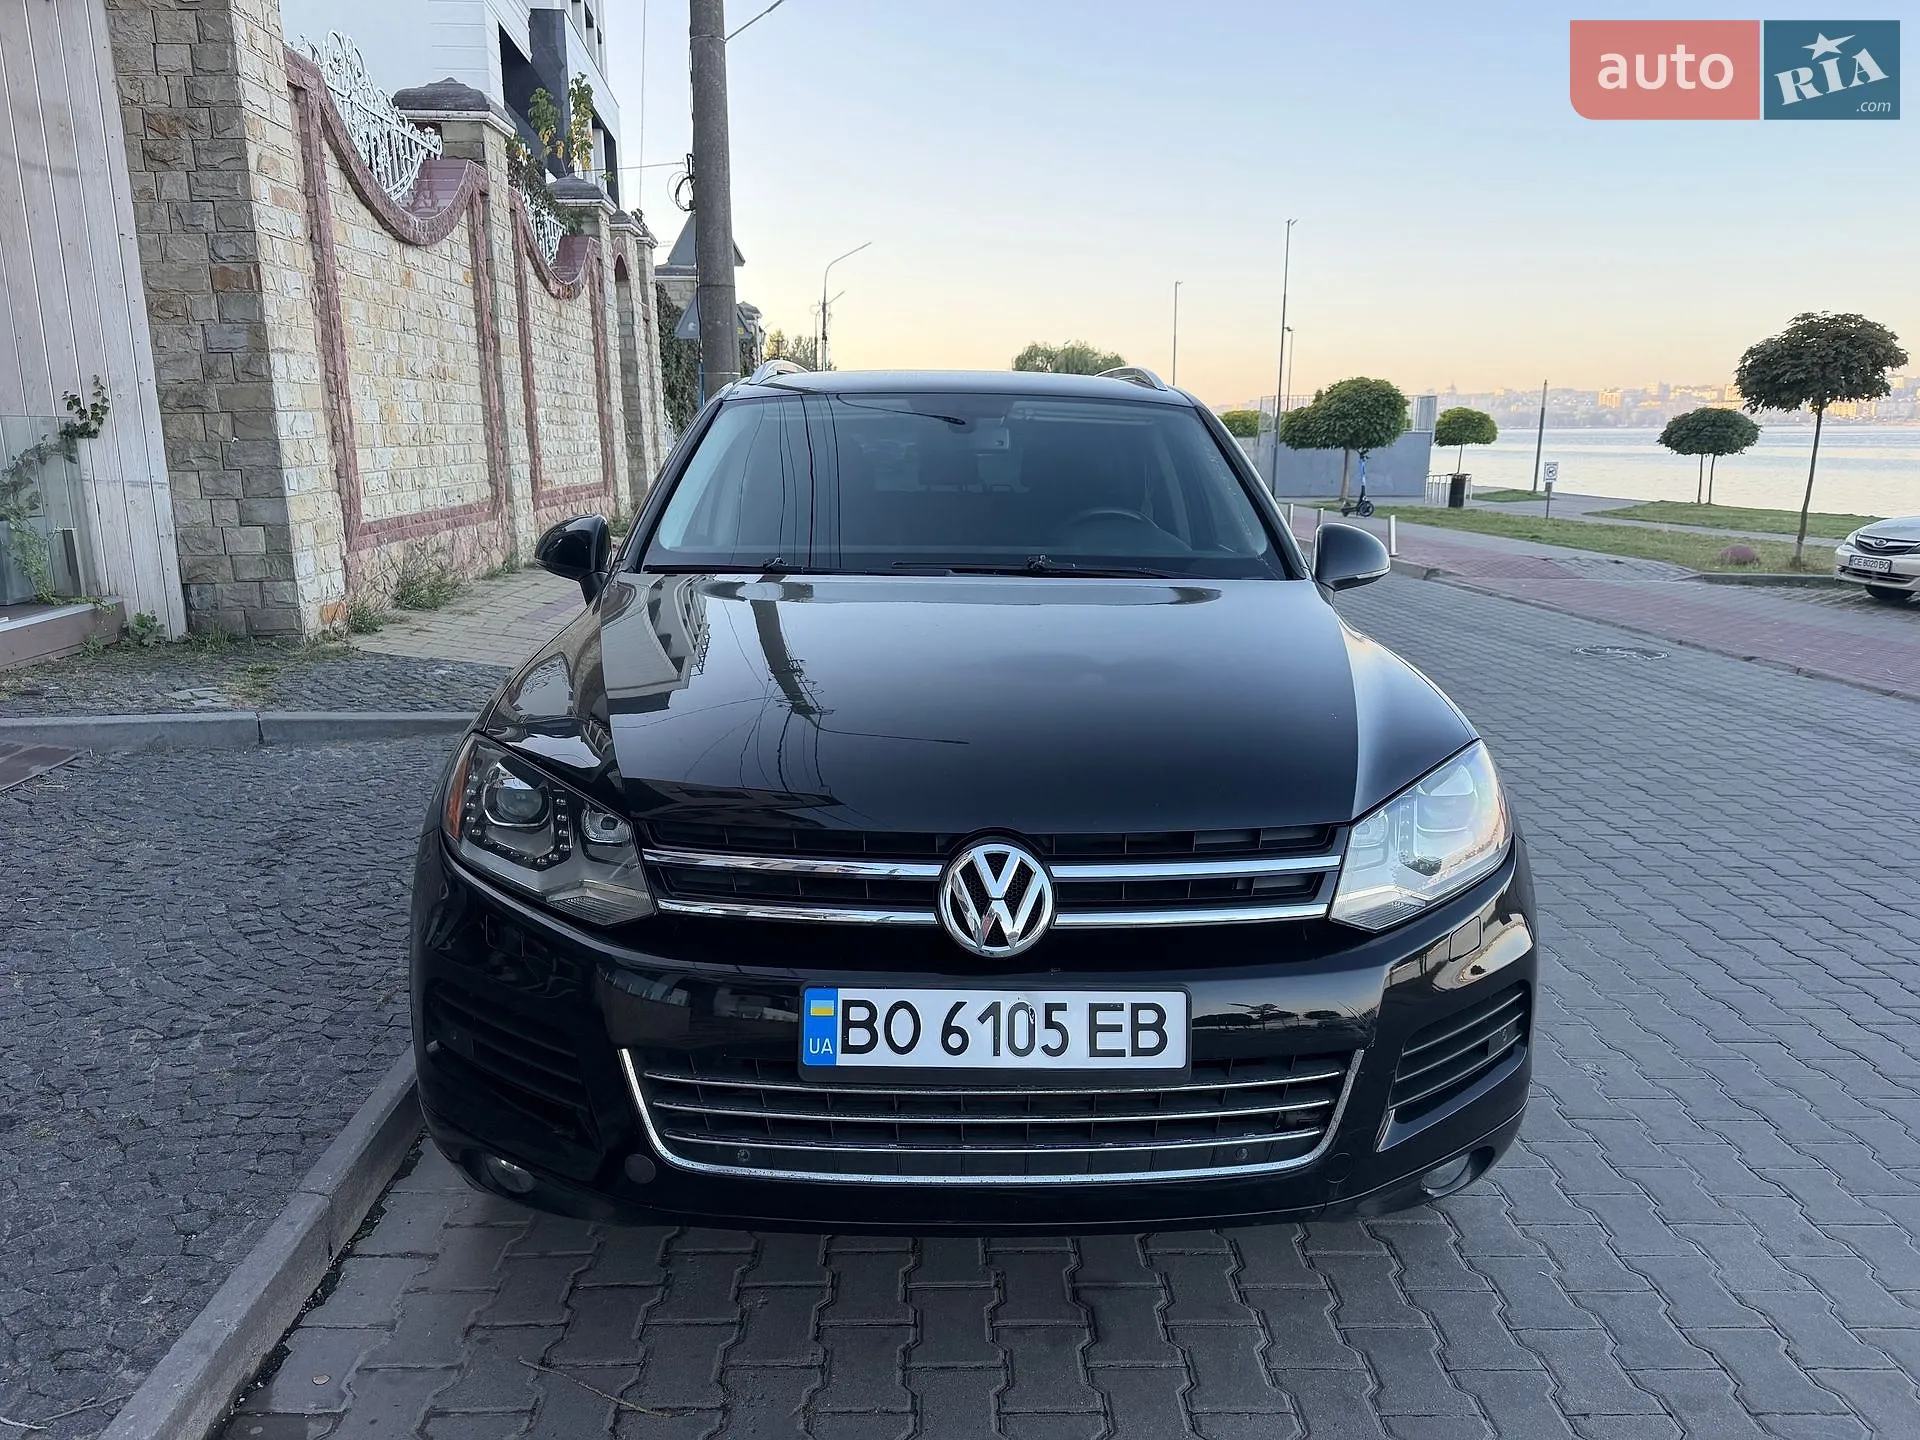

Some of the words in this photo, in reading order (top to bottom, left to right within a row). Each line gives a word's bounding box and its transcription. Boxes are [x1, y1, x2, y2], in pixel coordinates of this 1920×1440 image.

[943, 845, 1051, 955] VW
[809, 1037, 833, 1055] UA
[841, 999, 922, 1056] BO
[940, 1000, 1070, 1058] 6105
[1088, 1002, 1168, 1058] EB
